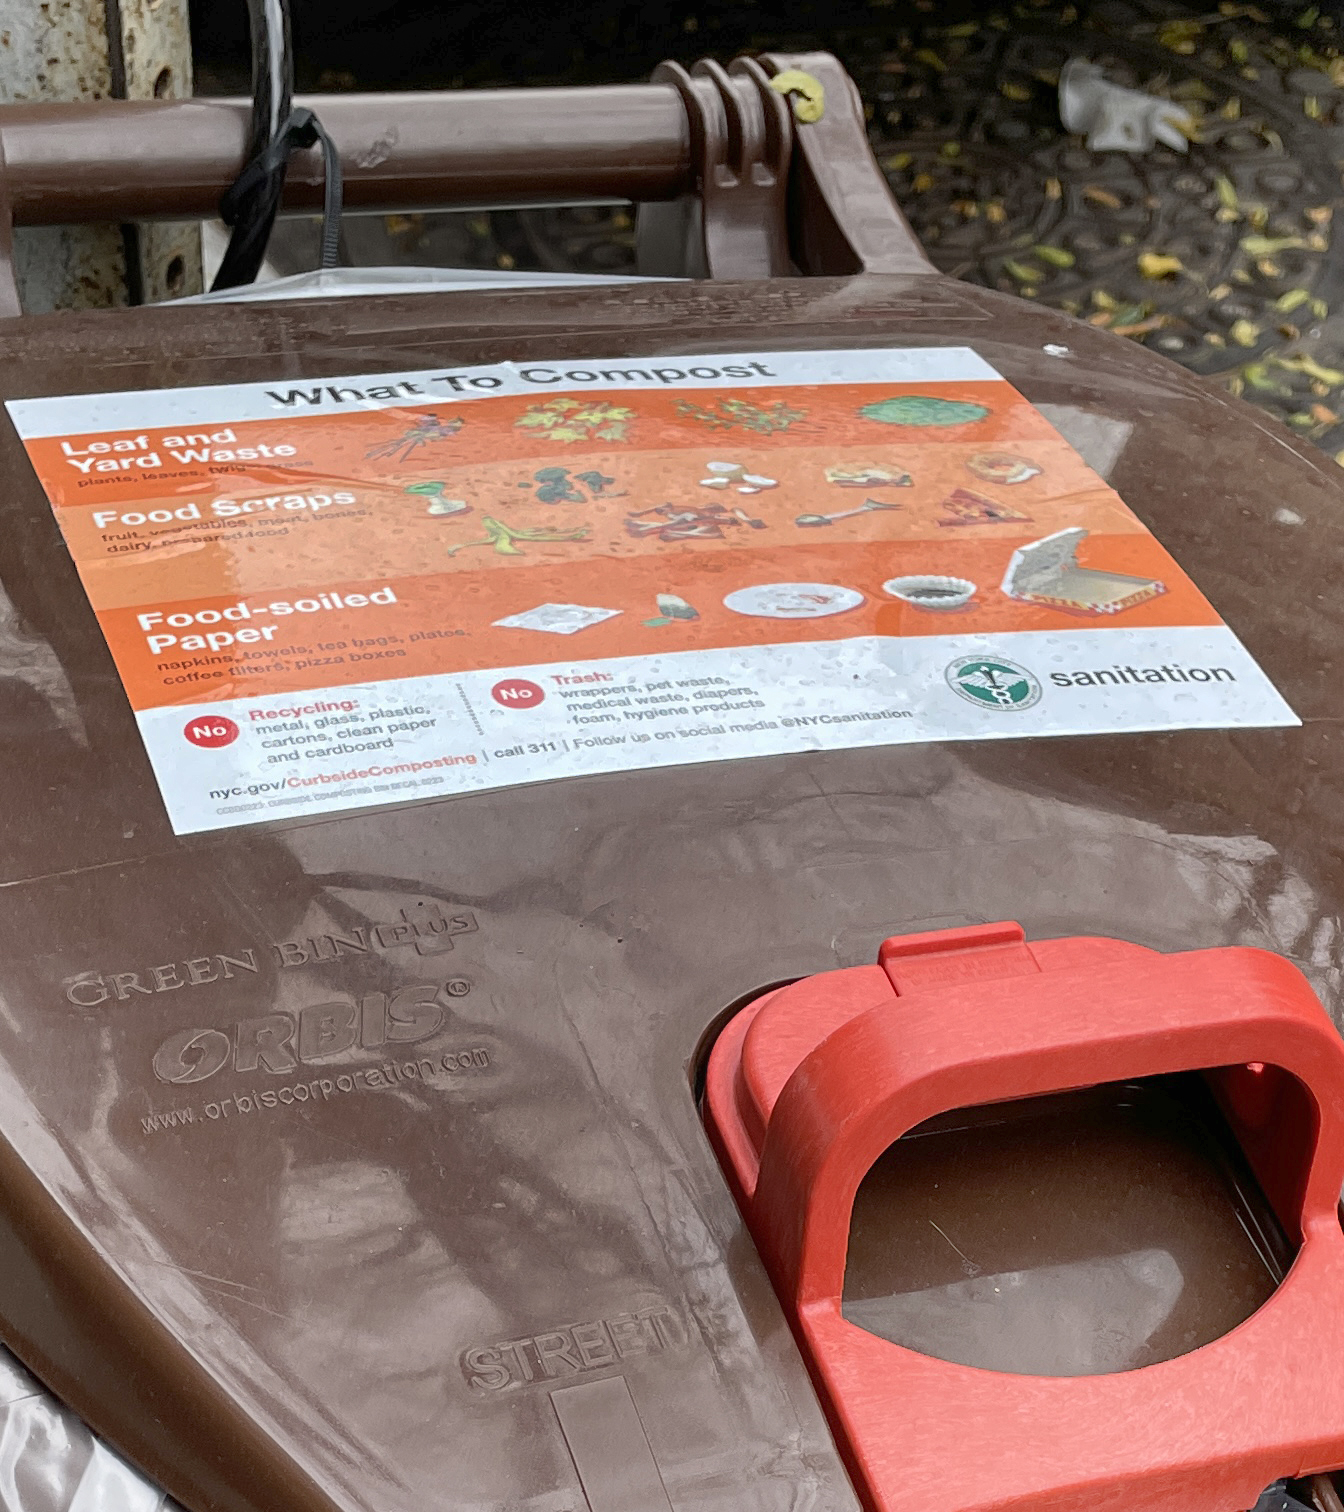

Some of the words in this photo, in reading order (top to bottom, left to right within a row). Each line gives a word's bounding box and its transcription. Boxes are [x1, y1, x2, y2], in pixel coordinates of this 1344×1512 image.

[265, 380, 424, 407] What
[432, 375, 504, 393] To
[520, 361, 777, 385] Compost
[61, 435, 149, 457] Leaf
[162, 429, 237, 447] and
[67, 453, 161, 474] Yard
[170, 443, 297, 464] Waste
[77, 477, 138, 488] plants,
[92, 503, 201, 528] Food
[210, 491, 357, 516] Scraps
[137, 587, 398, 632] Food-soiled
[146, 623, 280, 655] Paper
[157, 655, 241, 673] napkins,
[242, 645, 313, 660] towels,
[317, 639, 347, 651] tea
[352, 634, 405, 649] bags,
[163, 669, 224, 686] coffee
[294, 654, 346, 671] pizza
[349, 648, 408, 662] boxes
[551, 672, 614, 686] Trash:
[1050, 663, 1238, 689] sanitation
[499, 687, 533, 701] No
[558, 684, 643, 700] wrappers,
[646, 679, 673, 693] pet
[675, 676, 731, 689] waste,
[566, 696, 633, 712] medical
[634, 692, 690, 706] waste,
[692, 685, 759, 702] diapers,
[248, 699, 362, 722] Recycling:
[255, 720, 310, 736] metal,
[313, 713, 366, 731] glass,
[368, 703, 432, 722] plastic,
[623, 705, 689, 723] hygiene
[691, 696, 766, 716] products
[192, 725, 227, 740] No
[261, 731, 333, 749] cartons,
[336, 723, 385, 740] clean
[387, 717, 437, 736] paper
[208, 752, 478, 801] nyc.gov/CurbsideComposting
[493, 746, 525, 760] call
[527, 741, 557, 755] 311
[573, 734, 627, 750] Follow
[631, 732, 651, 745] us
[654, 730, 676, 743] on
[680, 723, 726, 738] social
[729, 719, 779, 734] media
[781, 709, 914, 728] @NYCsanitation
[267, 749, 301, 764] and
[305, 737, 395, 760] cardboard
[64, 948, 259, 1007] GREEN
[274, 927, 369, 969] BIN
[394, 914, 469, 943] PLUS
[139, 1044, 491, 1135] www.orbiscorporation.com
[462, 1304, 672, 1392] STREET
